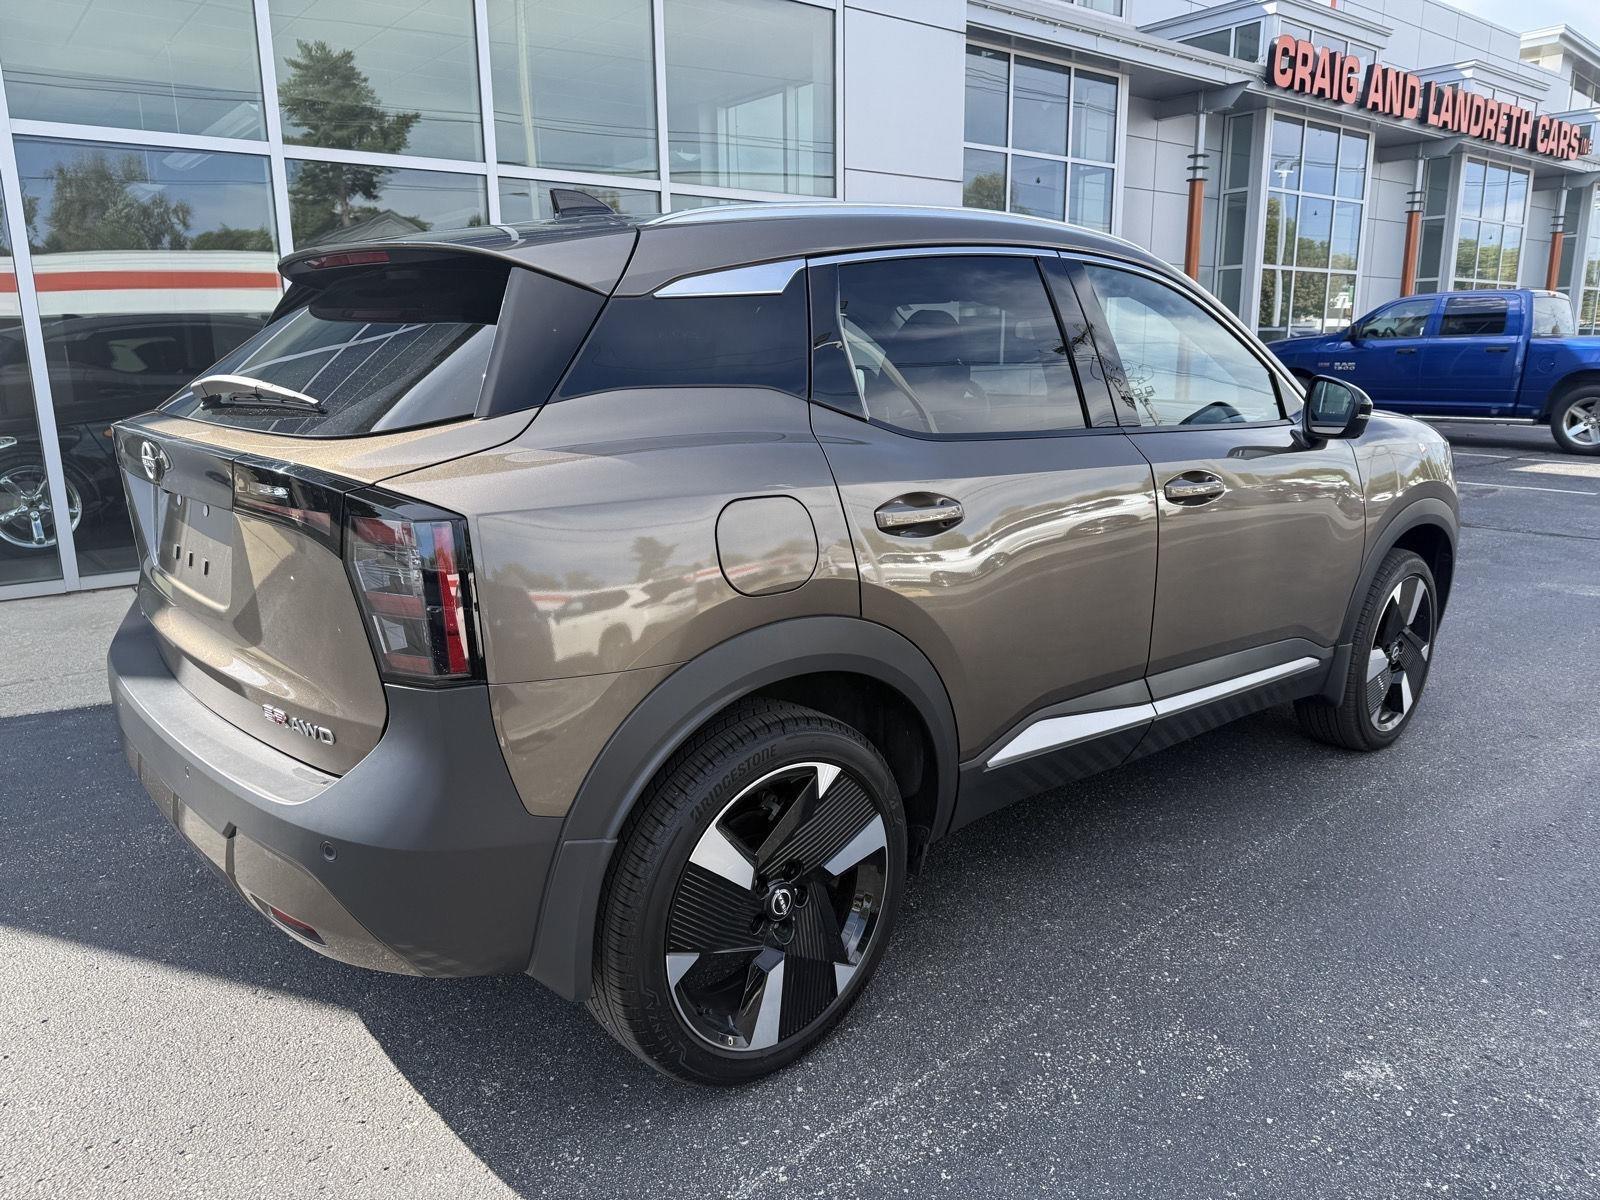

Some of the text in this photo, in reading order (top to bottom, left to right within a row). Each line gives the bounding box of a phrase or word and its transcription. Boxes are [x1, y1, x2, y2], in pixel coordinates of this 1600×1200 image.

[1271, 34, 1360, 104] CRAIG
[1366, 63, 1421, 120] AND
[1427, 80, 1533, 149] LANDRETH
[1536, 115, 1580, 160] CARS
[292, 717, 335, 746] AWD
